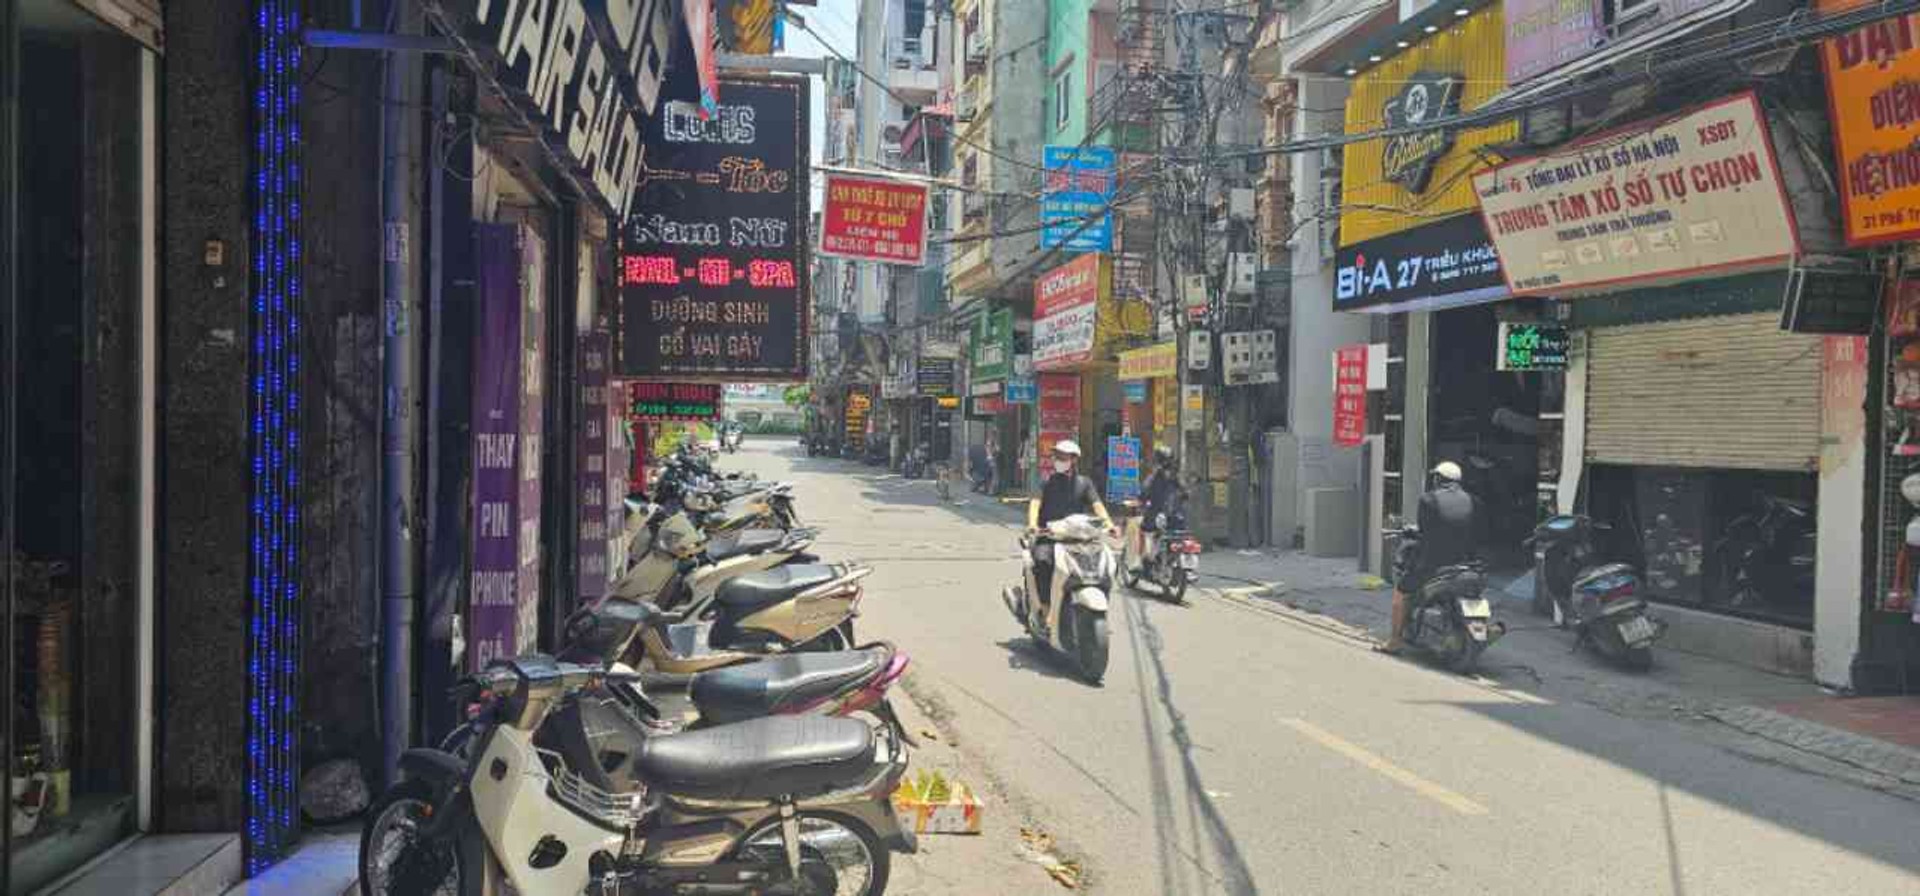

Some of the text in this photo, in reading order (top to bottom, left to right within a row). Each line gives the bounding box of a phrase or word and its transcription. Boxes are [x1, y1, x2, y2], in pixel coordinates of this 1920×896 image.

[1492, 151, 1763, 235] TRUNG TÂM XỔ SỐ TỰ CHỌN
[632, 214, 720, 247] Nam
[1397, 257, 1422, 289] 27
[723, 300, 769, 325] SINH
[691, 333, 721, 357] VAI
[478, 433, 515, 468] THAY
[481, 502, 509, 537] PIN
[471, 571, 516, 606] IPHONE
